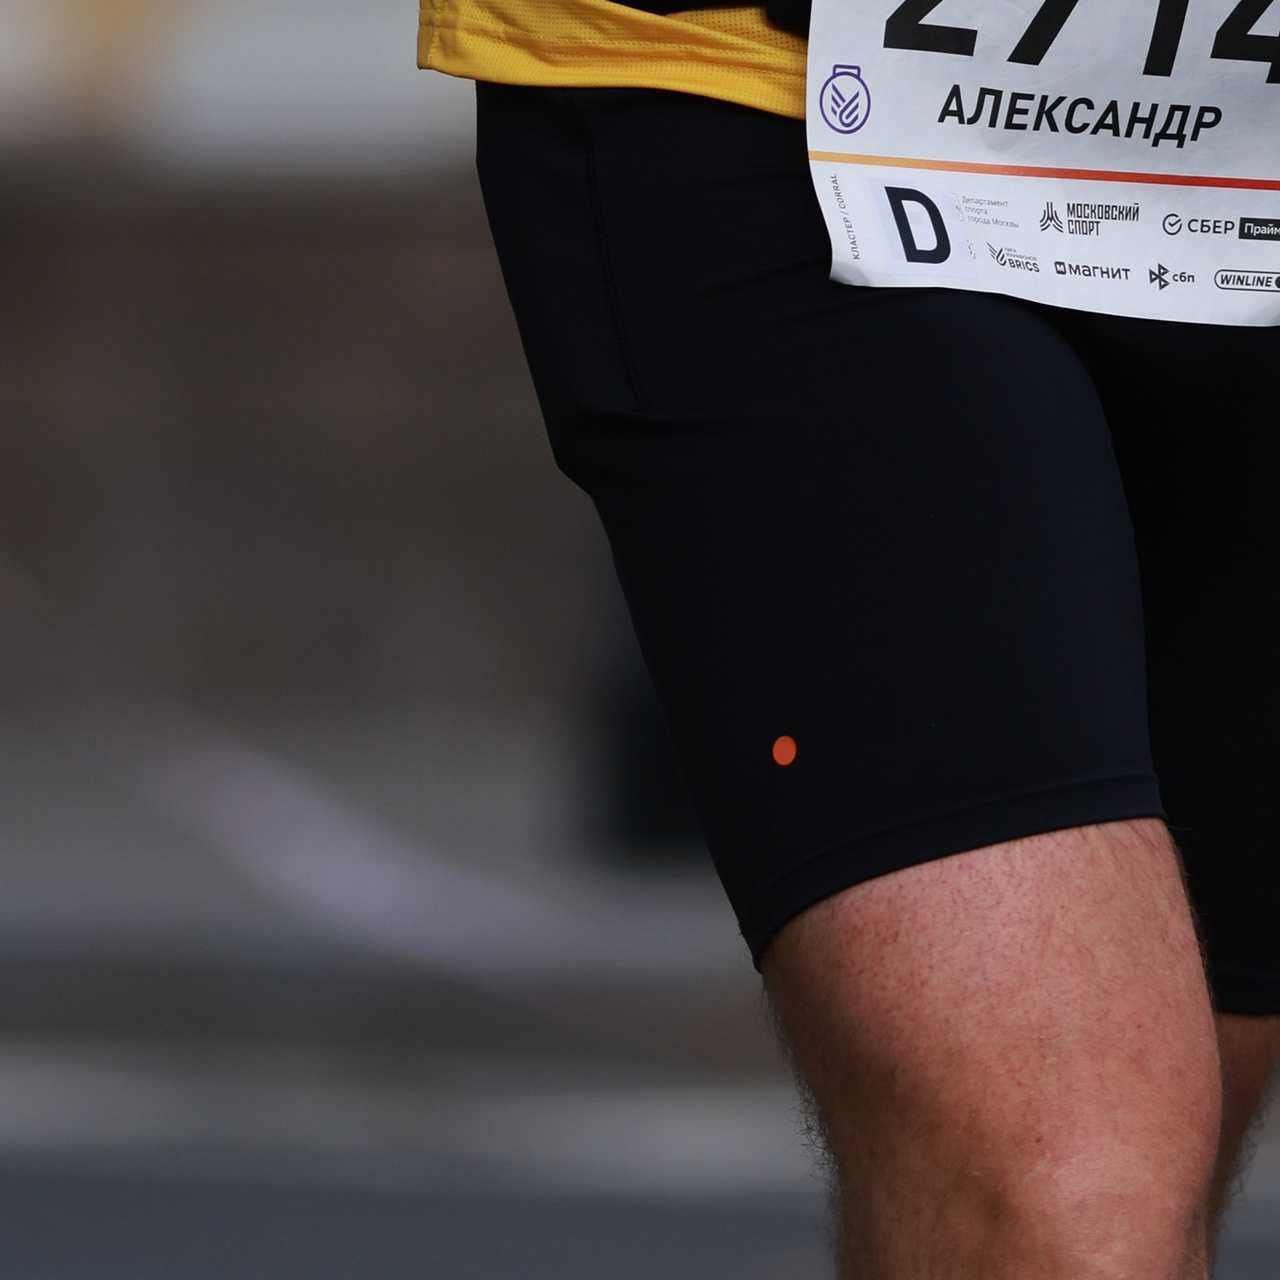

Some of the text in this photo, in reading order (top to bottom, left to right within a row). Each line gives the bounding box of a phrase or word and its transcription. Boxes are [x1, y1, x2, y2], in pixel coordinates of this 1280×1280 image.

[937, 83, 1223, 149] АЛЕКСАНДР
[829, 173, 847, 210] CORRAL
[1066, 202, 1140, 221] МОСКОВСКИЙ
[884, 186, 951, 264] D
[1067, 220, 1101, 236] СПОРТ
[1187, 218, 1235, 235] СБЕР
[842, 217, 860, 260] КЛАСТЕР
[1007, 258, 1040, 273] BRICS
[1172, 272, 1195, 283] сбп
[1219, 273, 1274, 288] WINLINE
